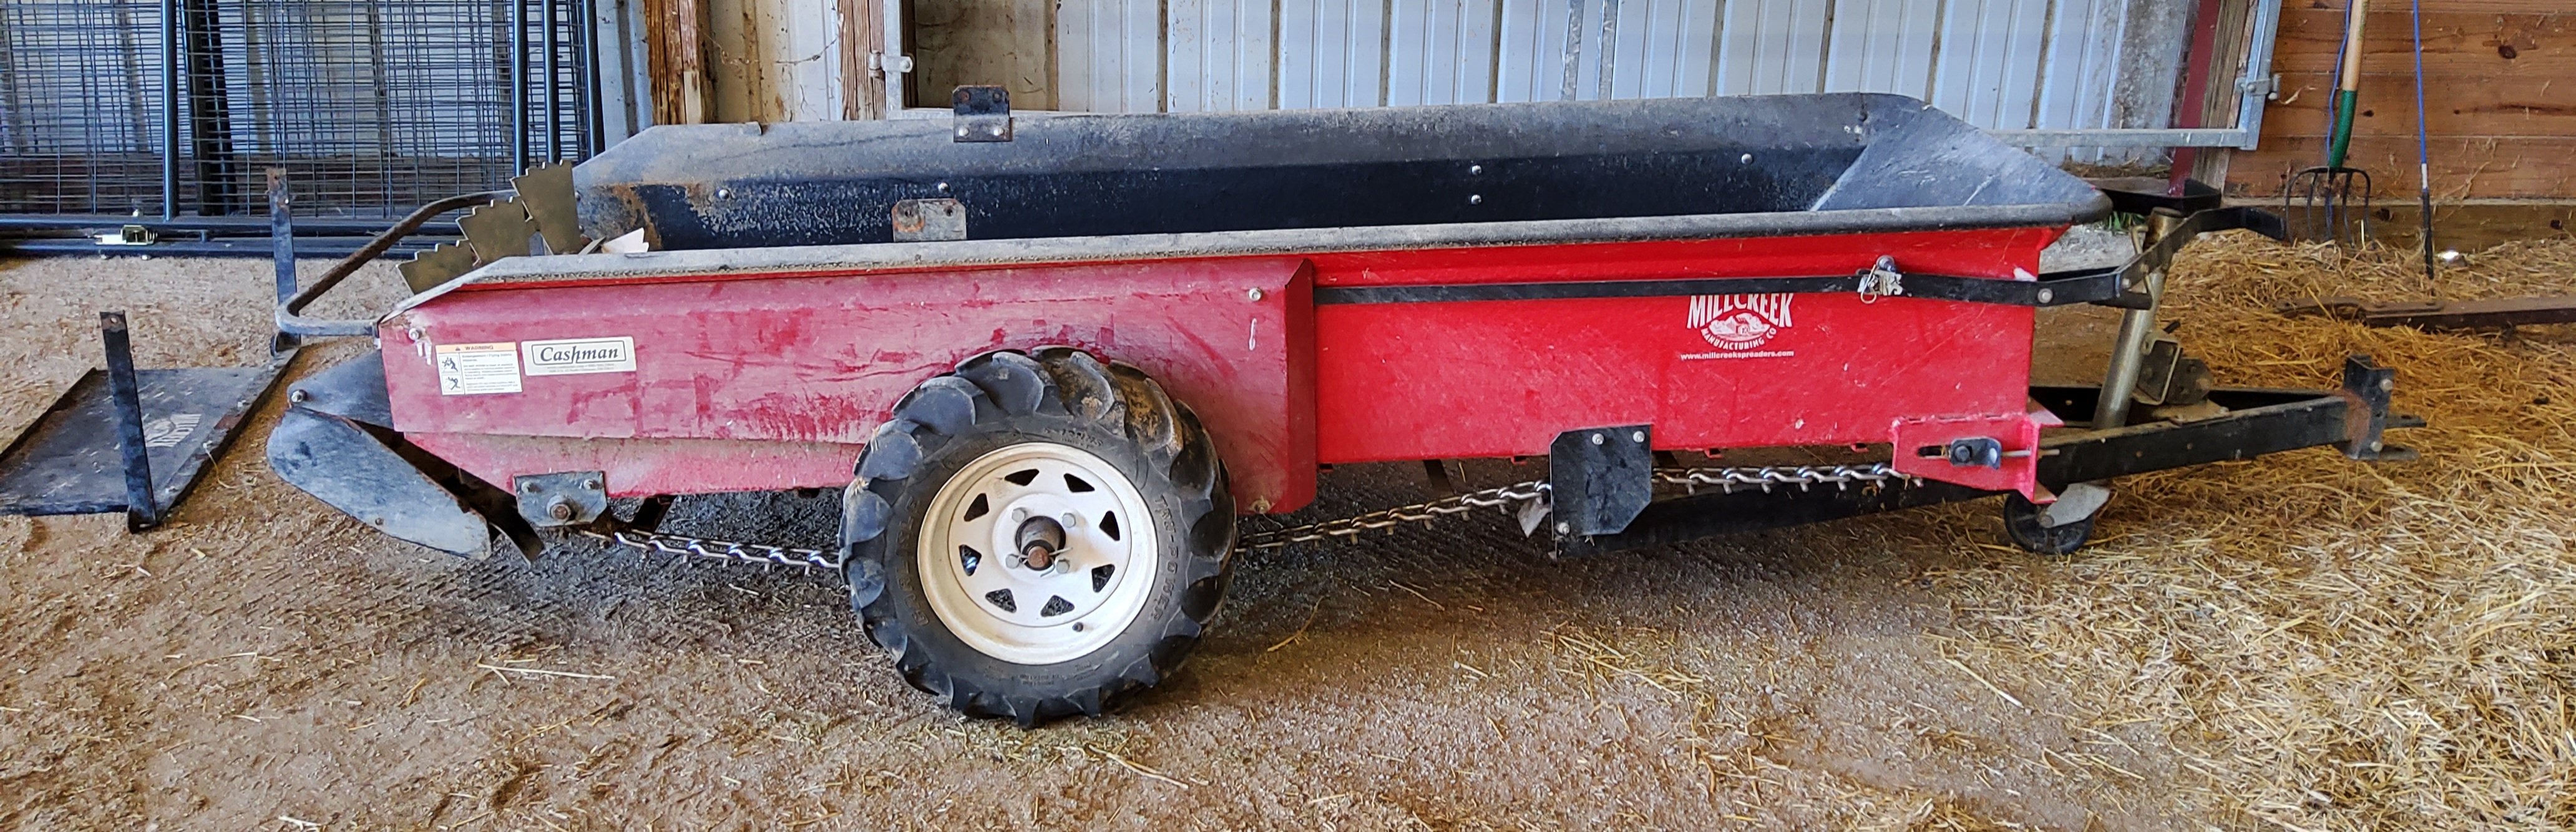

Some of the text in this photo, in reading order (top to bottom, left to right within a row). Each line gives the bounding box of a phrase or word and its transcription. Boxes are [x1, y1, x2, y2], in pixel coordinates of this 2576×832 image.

[1687, 293, 1793, 329] MILLCREEK
[1700, 327, 1765, 351] MANUFACTURING
[540, 345, 619, 364] Cashman
[1680, 350, 1795, 361] www.millcreekspreaders.com
